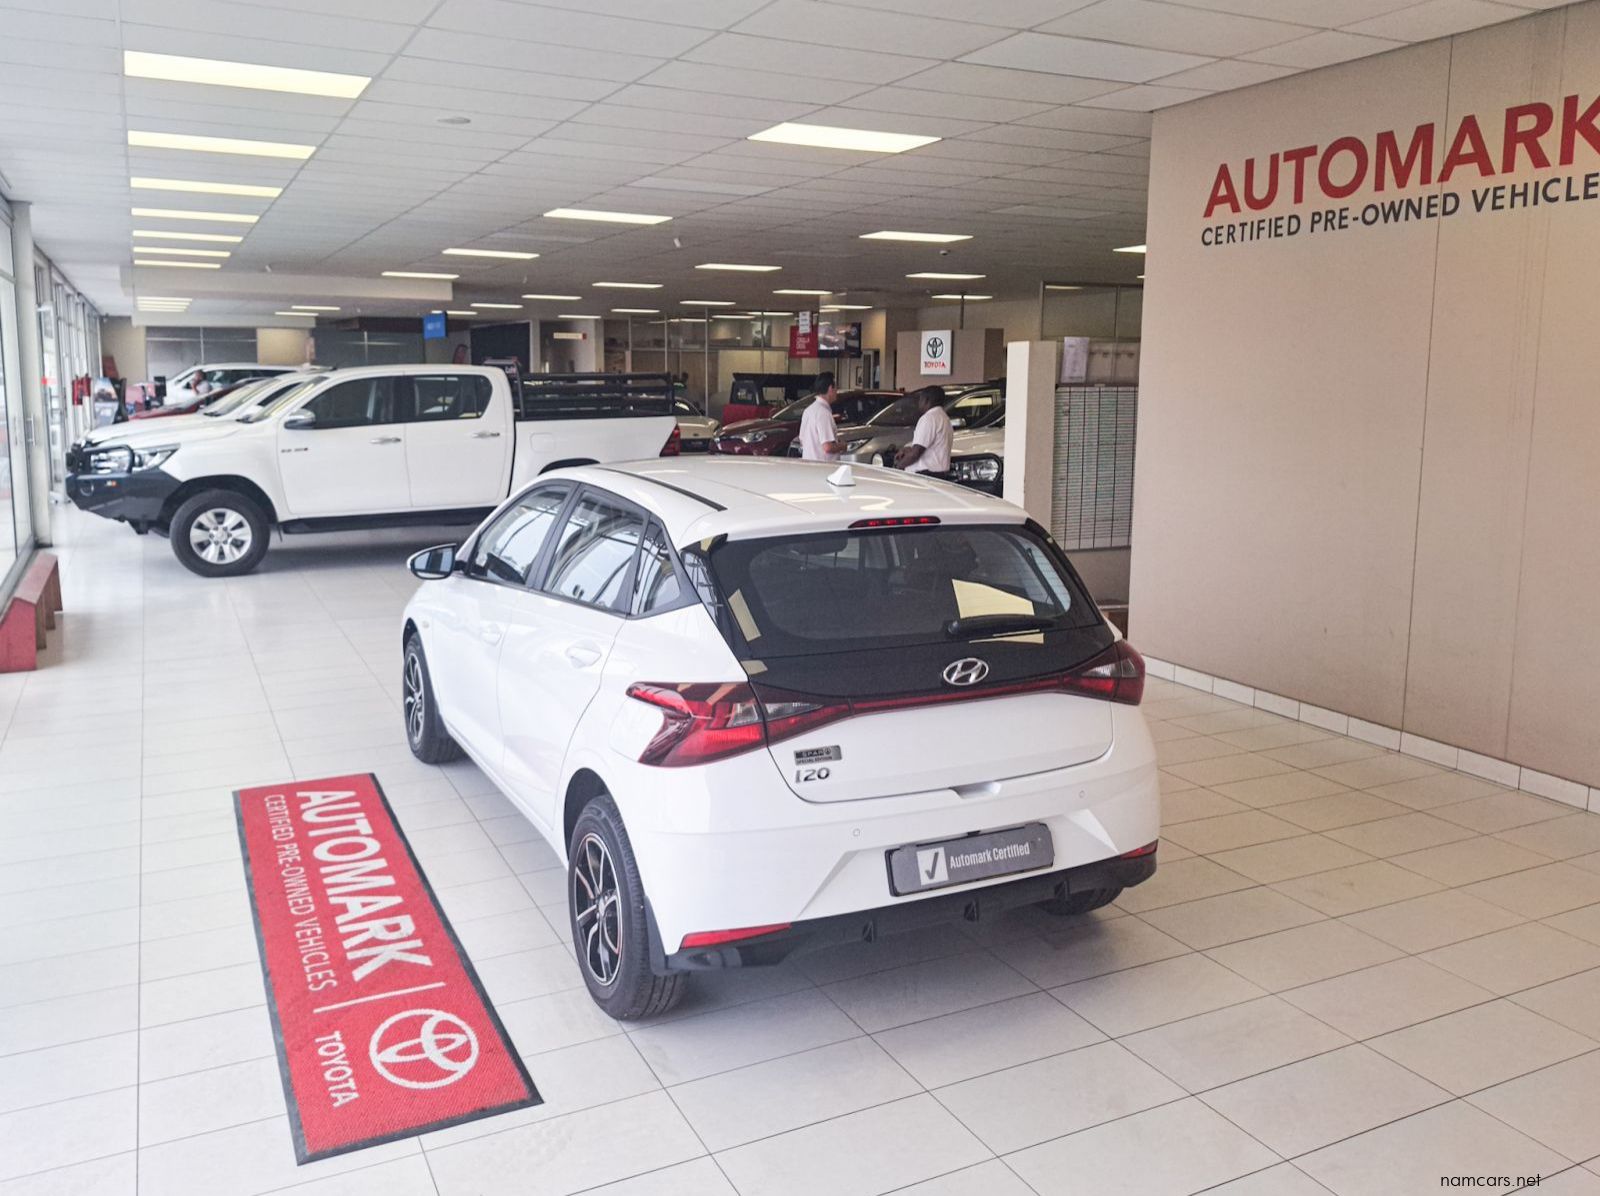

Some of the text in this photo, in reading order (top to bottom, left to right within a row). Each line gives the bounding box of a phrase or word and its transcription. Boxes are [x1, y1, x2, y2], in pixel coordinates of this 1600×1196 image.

[1203, 94, 1600, 218] AUTOMARK
[1201, 215, 1301, 246] CERTIFIED
[1310, 191, 1460, 233] PRE-OWNED
[924, 361, 946, 369] TOYOTA
[264, 794, 337, 992] CERTIFIED PRE-OWNED VEHICLES
[296, 790, 432, 982] AUTOMARK
[949, 842, 1030, 869] Automark Certified
[315, 1030, 360, 1108] TOYOTA
